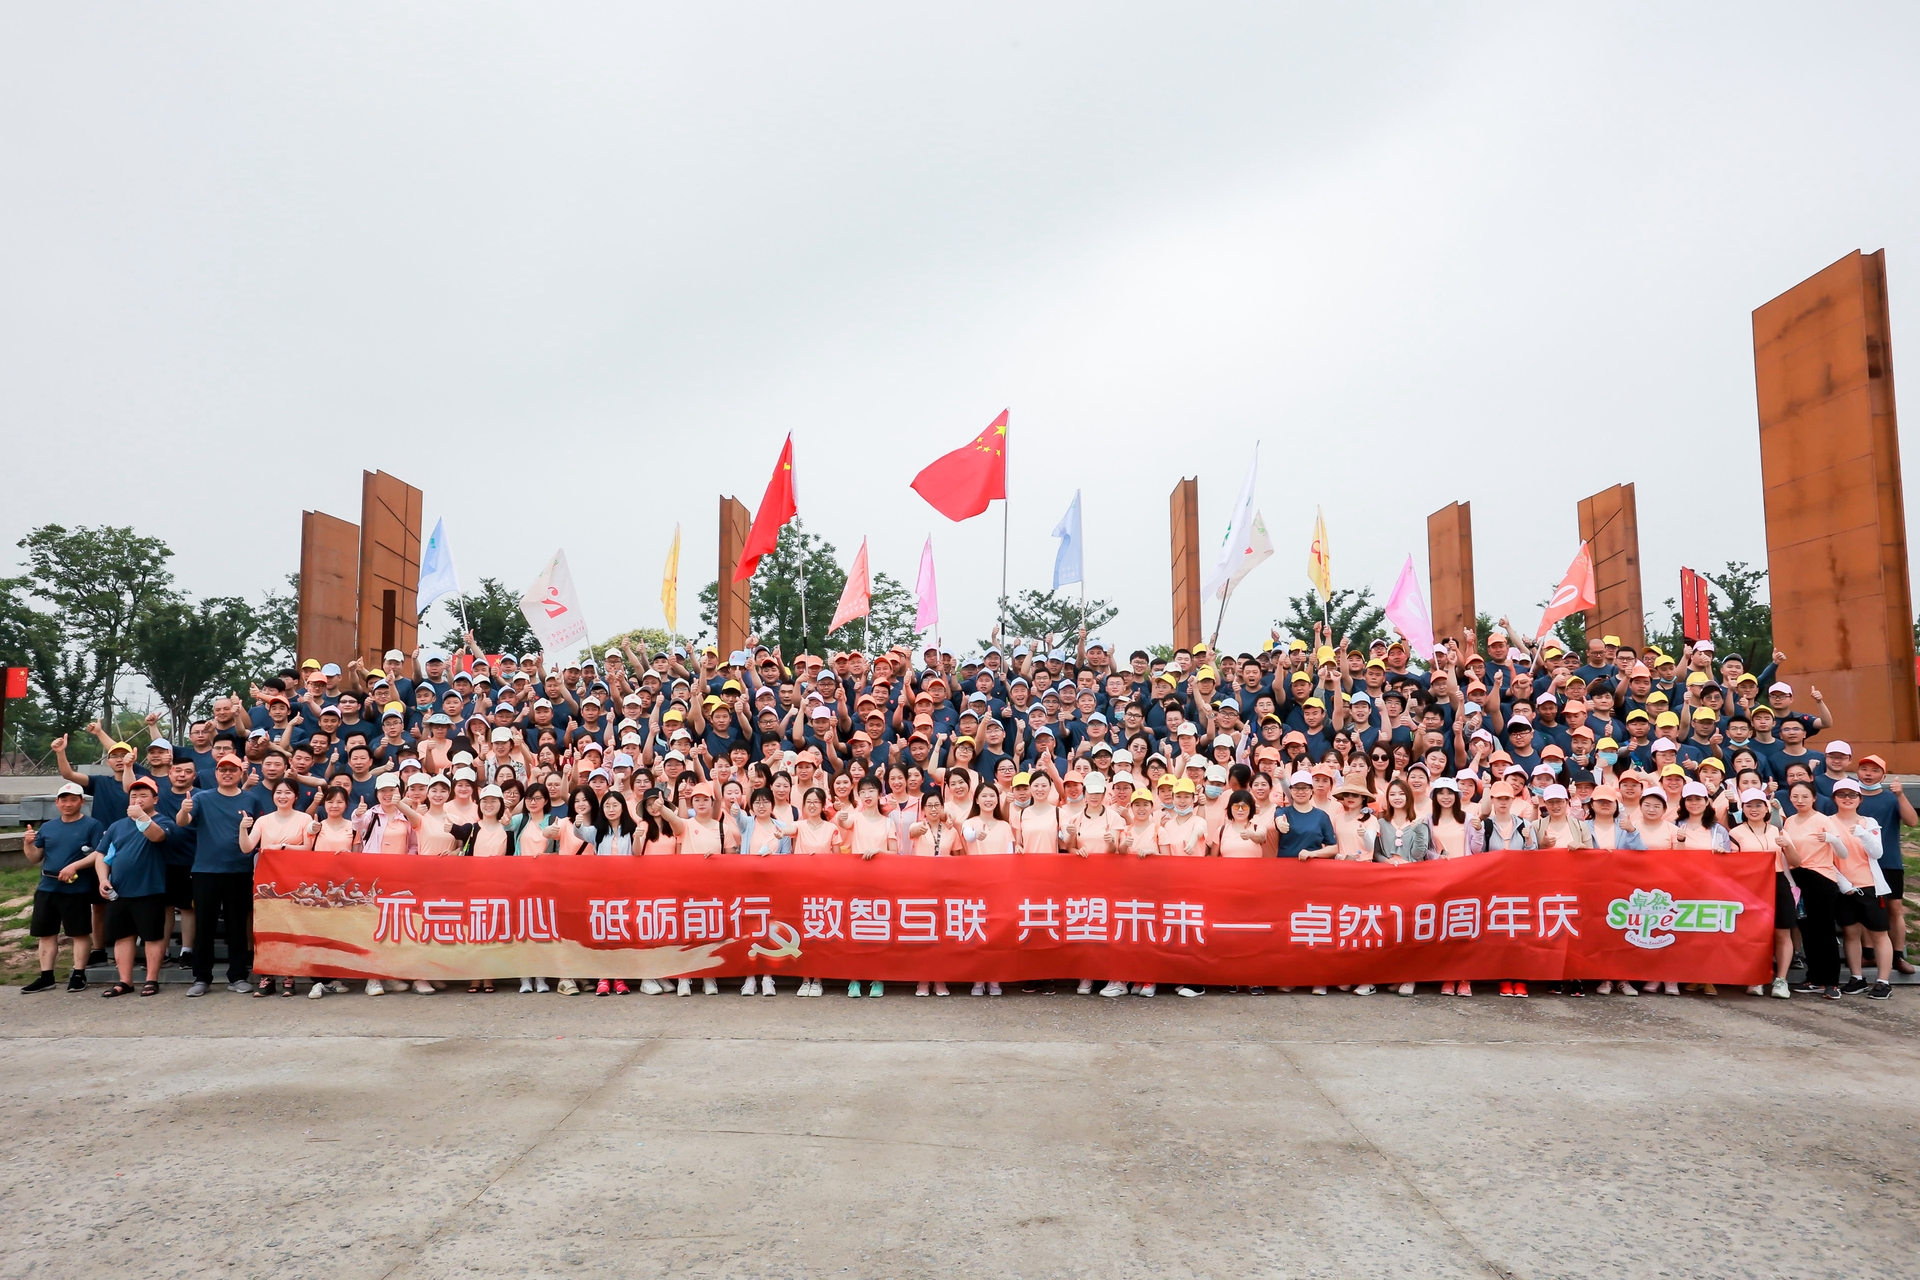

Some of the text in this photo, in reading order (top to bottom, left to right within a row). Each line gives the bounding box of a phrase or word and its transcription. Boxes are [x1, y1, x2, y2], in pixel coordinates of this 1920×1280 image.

[1632, 892, 1671, 911] 卓然
[375, 897, 559, 941] 不忘初心
[588, 896, 772, 941] 砥砺前行
[802, 897, 987, 942] 数智互联
